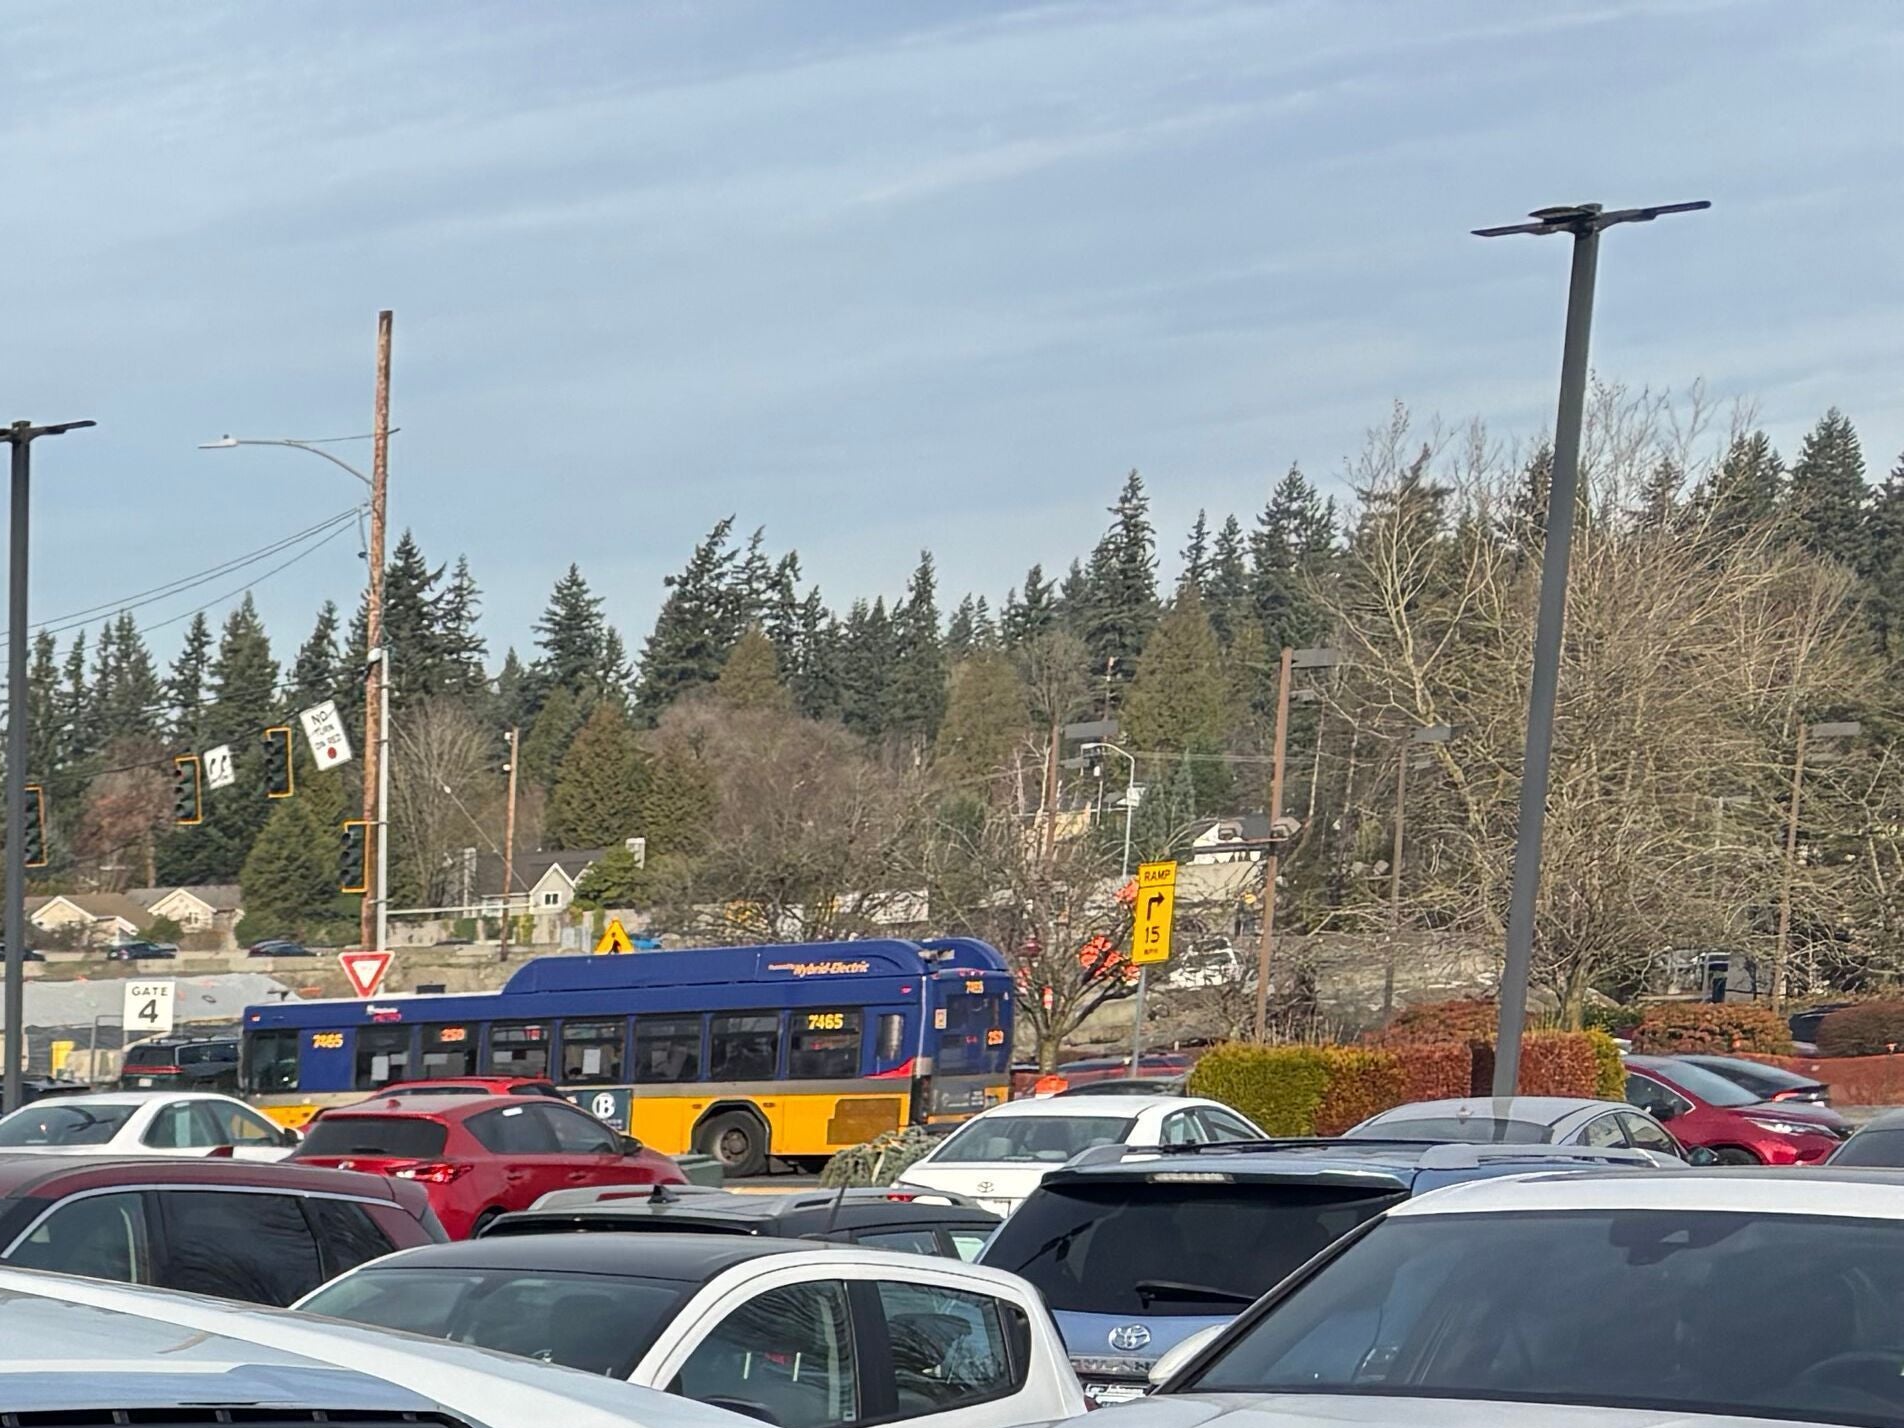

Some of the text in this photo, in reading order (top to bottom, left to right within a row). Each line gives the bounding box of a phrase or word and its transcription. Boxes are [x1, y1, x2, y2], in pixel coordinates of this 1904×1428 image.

[311, 711, 328, 725] NO
[1143, 869, 1171, 882] RAMP
[1145, 926, 1160, 943] 15
[131, 986, 168, 996] GATE
[138, 999, 159, 1023] 4
[808, 1013, 844, 1030] 7465
